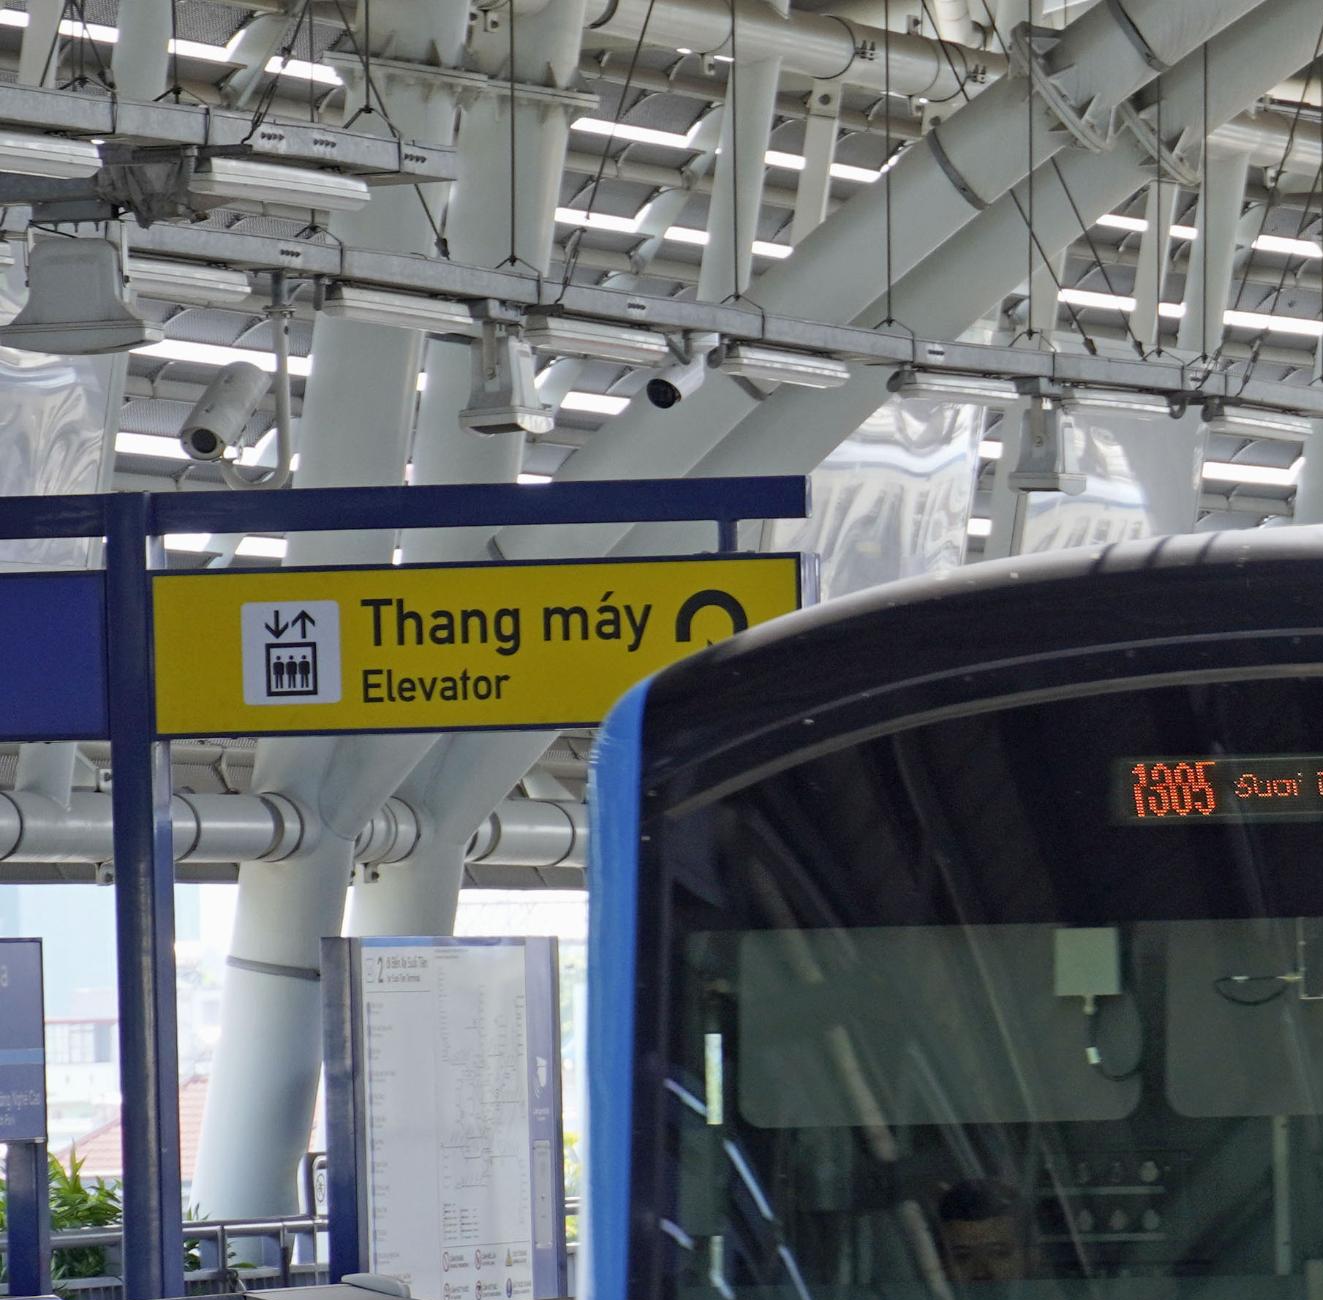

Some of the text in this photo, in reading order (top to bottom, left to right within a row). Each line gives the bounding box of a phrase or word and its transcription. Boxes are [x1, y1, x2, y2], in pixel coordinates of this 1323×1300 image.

[360, 592, 652, 656] Thang máy
[361, 668, 511, 704] Elevator
